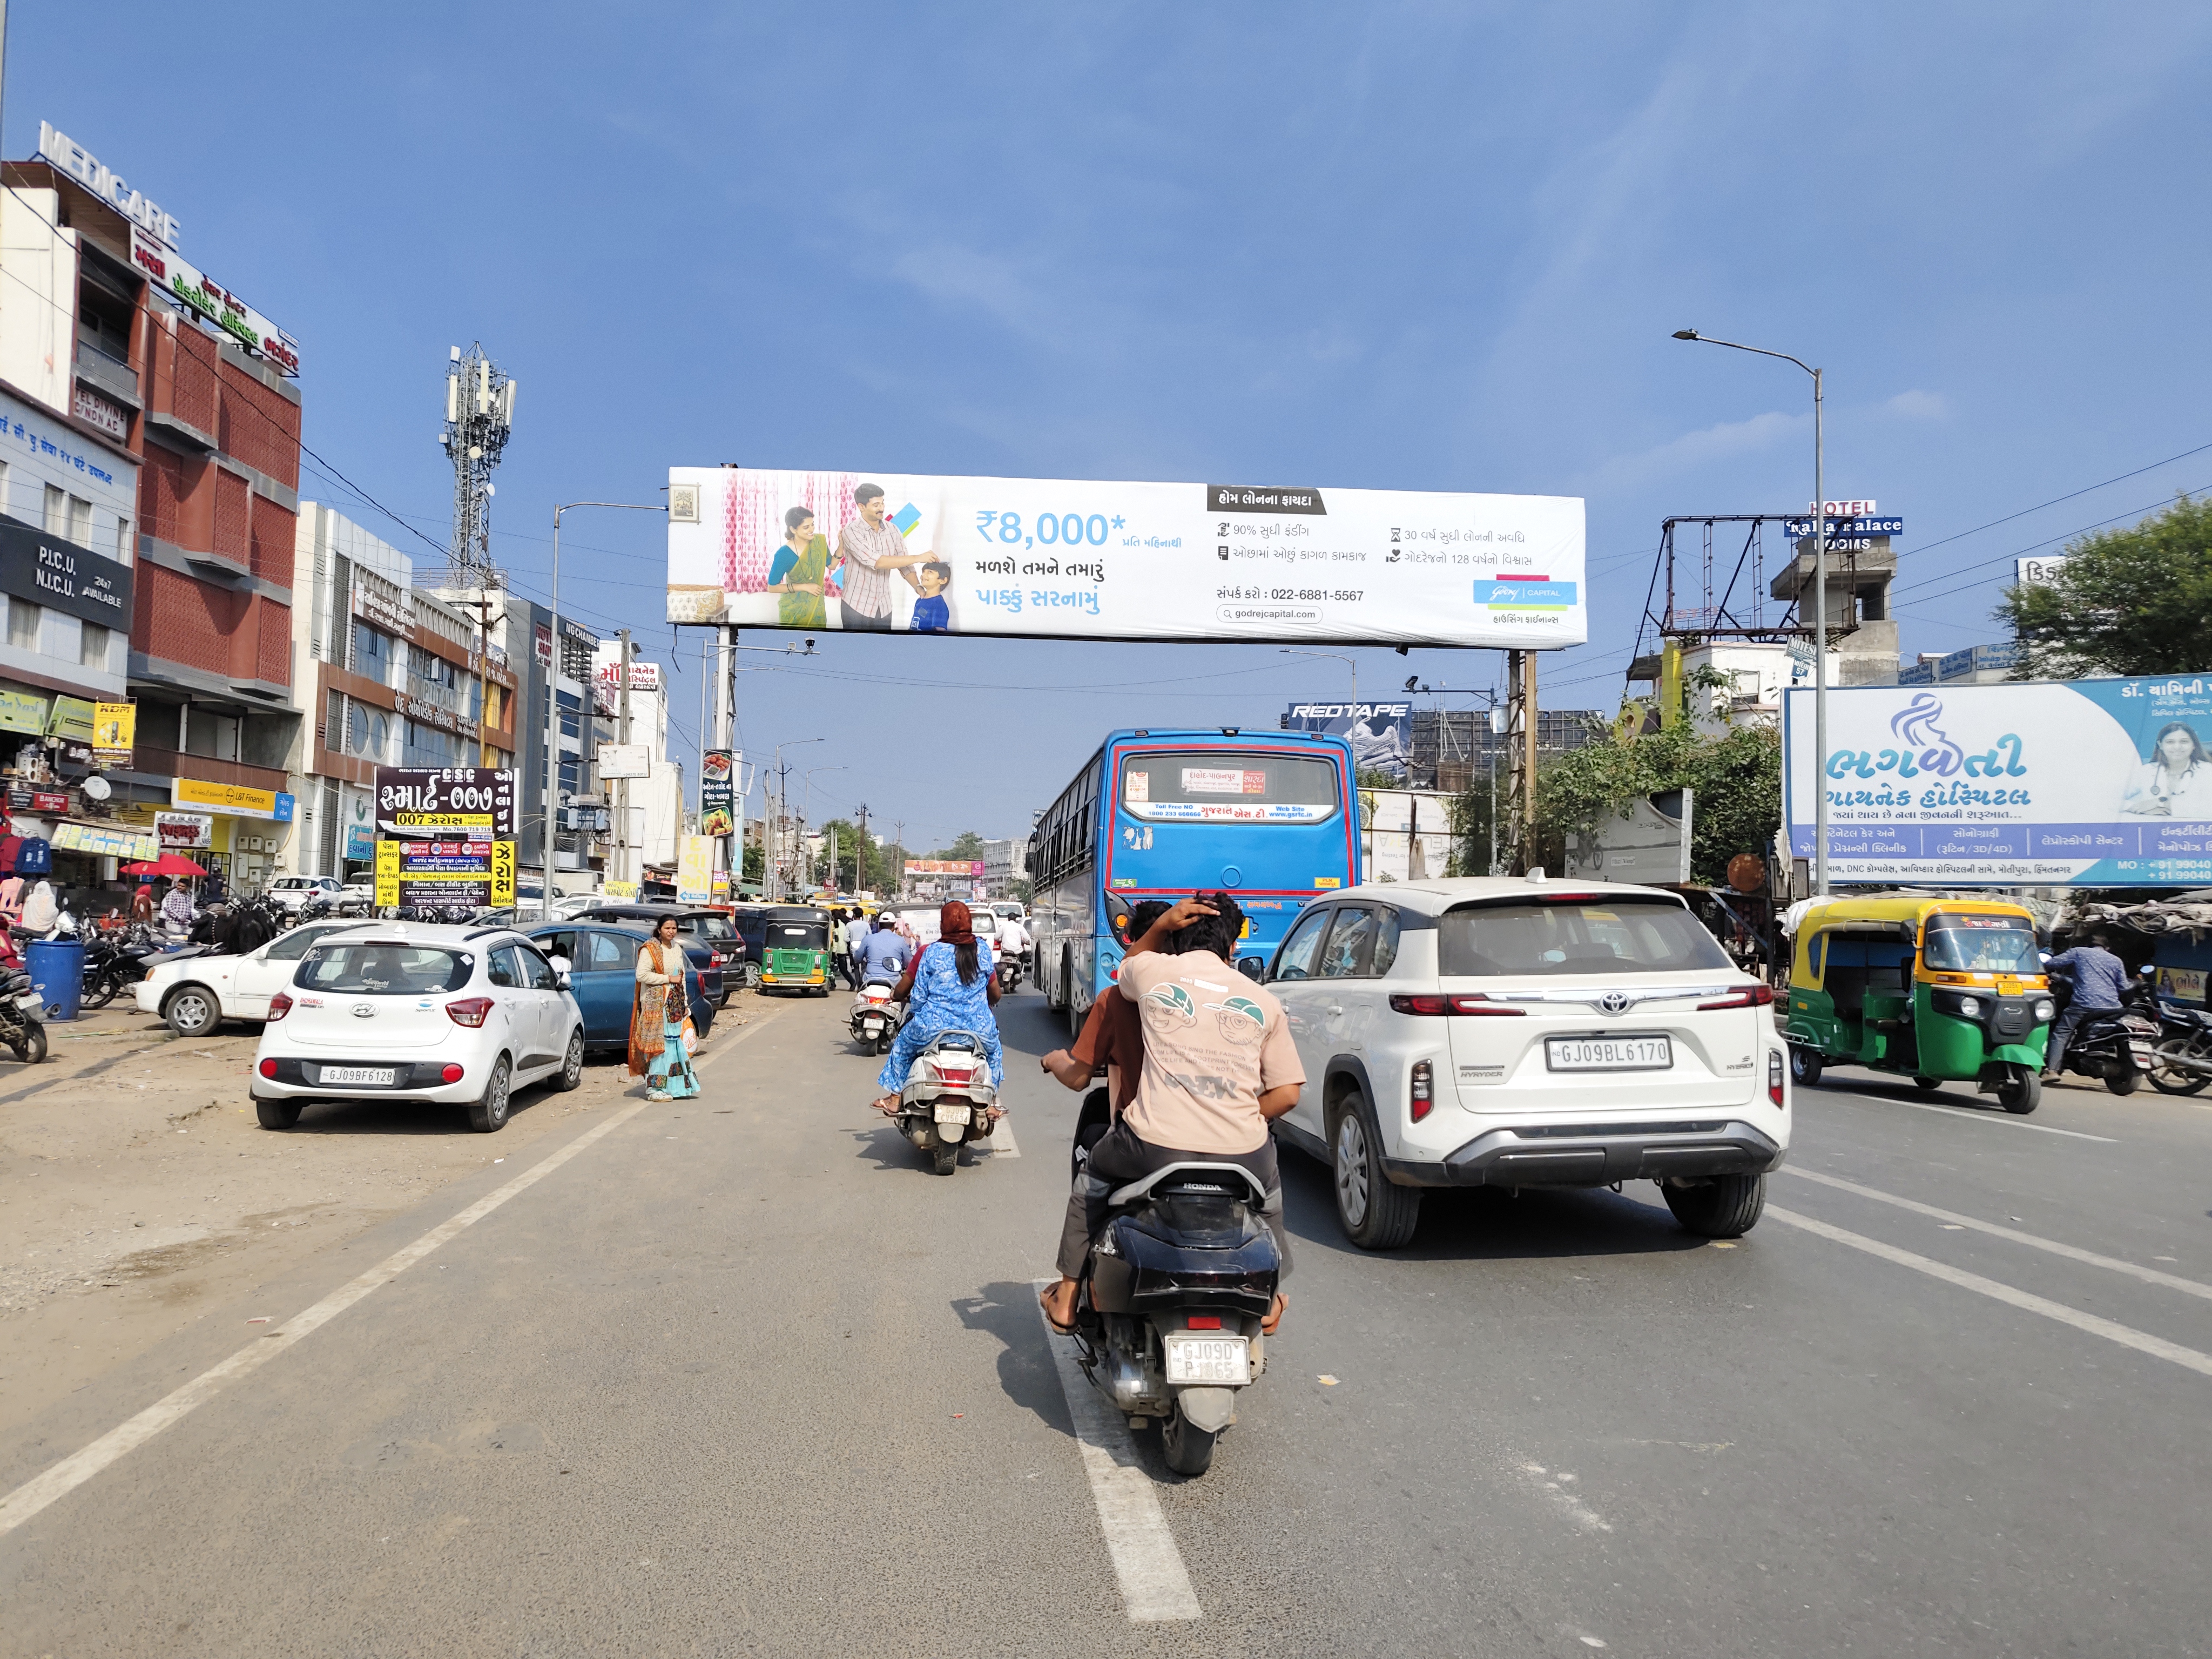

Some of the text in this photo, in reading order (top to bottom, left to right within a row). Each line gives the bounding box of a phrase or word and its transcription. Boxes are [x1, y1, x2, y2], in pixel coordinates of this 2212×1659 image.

[41, 120, 180, 252] MEDICARE
[220, 306, 259, 345] હોસ્પિટલ
[264, 337, 299, 372] ભગંદર
[95, 397, 125, 422] DIVINE
[107, 417, 118, 431] AC
[41, 435, 85, 472] सेवा २४ घंटे
[1218, 489, 1312, 507] હોમ લોનના ફાયદા
[1810, 501, 1874, 515] HOTEL
[1233, 523, 1310, 539] 90% સુધી ફંડીંગ
[1842, 519, 1903, 532] Palace
[1122, 535, 1182, 549] પ્રતિ મહિનાથી
[1404, 528, 1525, 544] 30 વર્ષ સુધી લોનની અવધિ
[39, 545, 76, 576] P.I.C.U.
[1232, 545, 1367, 563] ઓછામાં ઓછું કાગળ કામકાજ
[1404, 550, 1532, 566] ગોદરેજનો 128 વર્ષનો વિશ્વાસ
[975, 556, 1105, 583] મળશે તમને તમારું
[36, 568, 75, 597] N.I.C.U.
[94, 576, 112, 590] 24x7
[82, 586, 122, 608] AVAILABLE
[975, 582, 1101, 616] પાક્કું સરનામું
[1216, 585, 1364, 602] સંપર્ક કરો 022-6881-5567
[1527, 589, 1561, 597] CAPITAL
[1235, 609, 1316, 620] godrejcapital.com
[1493, 613, 1523, 624] હાઉસિંગ
[565, 622, 600, 649] MG CHAMBER
[1794, 660, 1810, 670] MITESH
[1796, 667, 1805, 676] 57
[2121, 679, 2203, 697] ડૉ. યામિની
[99, 704, 131, 713] KDM
[408, 697, 433, 722] ઓર્થોપેડીક
[434, 706, 453, 729] હોસ્પિટલ
[1292, 704, 1410, 718] REDTAPE
[1825, 733, 2028, 779] ભગવતી
[1190, 770, 1236, 782] દાહોદ-પાલનપુર
[235, 792, 245, 801] L&T
[246, 793, 265, 804] Finance
[380, 774, 493, 813] સ્માર્ટ-૦૦૭
[704, 791, 730, 800] ગોટા-ખમણ
[1919, 780, 2031, 808] હોસ્પિટલ
[1201, 806, 1232, 818] ગુજરાત
[1857, 808, 2022, 820] થાય છે નવા જીવનની શરૂઆત...
[399, 814, 462, 826] 007 ઝેરોક્ષ
[1860, 827, 1896, 838] કેર અને
[1952, 827, 1999, 838] સોનોગ્રાફી
[2041, 834, 2124, 846] લેપ્રોસ્કોપી સેન્ટર
[2157, 841, 2202, 852] મેનોપોઝ
[348, 842, 367, 855] દવાની
[1833, 842, 1907, 853] પ્રેગ્નન્સી ક્લિનીક
[470, 864, 485, 873] સુવિધા
[496, 842, 510, 893] ઝેરોક્ષ
[681, 837, 708, 890] દવાઓ
[1866, 864, 1898, 874] કોમ્પલેક્ષ,
[1900, 864, 1934, 873] આવિષ્કાર
[1936, 864, 1975, 874] હોસ્પિટલની
[1977, 864, 1996, 875] સામે,
[1998, 863, 2031, 876] મોતીપુરા,
[2034, 863, 2072, 874] હિંમતનગર
[2117, 861, 2137, 869] MO
[2176, 860, 2211, 869] 99040
[2176, 870, 2211, 880] 99040
[605, 886, 636, 898] પાસપોર્ટ કોપી
[493, 895, 512, 904] લેમીનેશન
[2176, 973, 2200, 990] ભોલે
[1193, 1054, 1230, 1065] FOOTPRINT
[1219, 1050, 1246, 1061] FASHION
[1562, 1043, 1667, 1063] GJ09BL6170
[329, 1070, 393, 1081] GJ09BF6128
[941, 1114, 968, 1123] CV5634
[1183, 1183, 1222, 1191] HONDA
[1184, 1343, 1232, 1360] GJ09D
